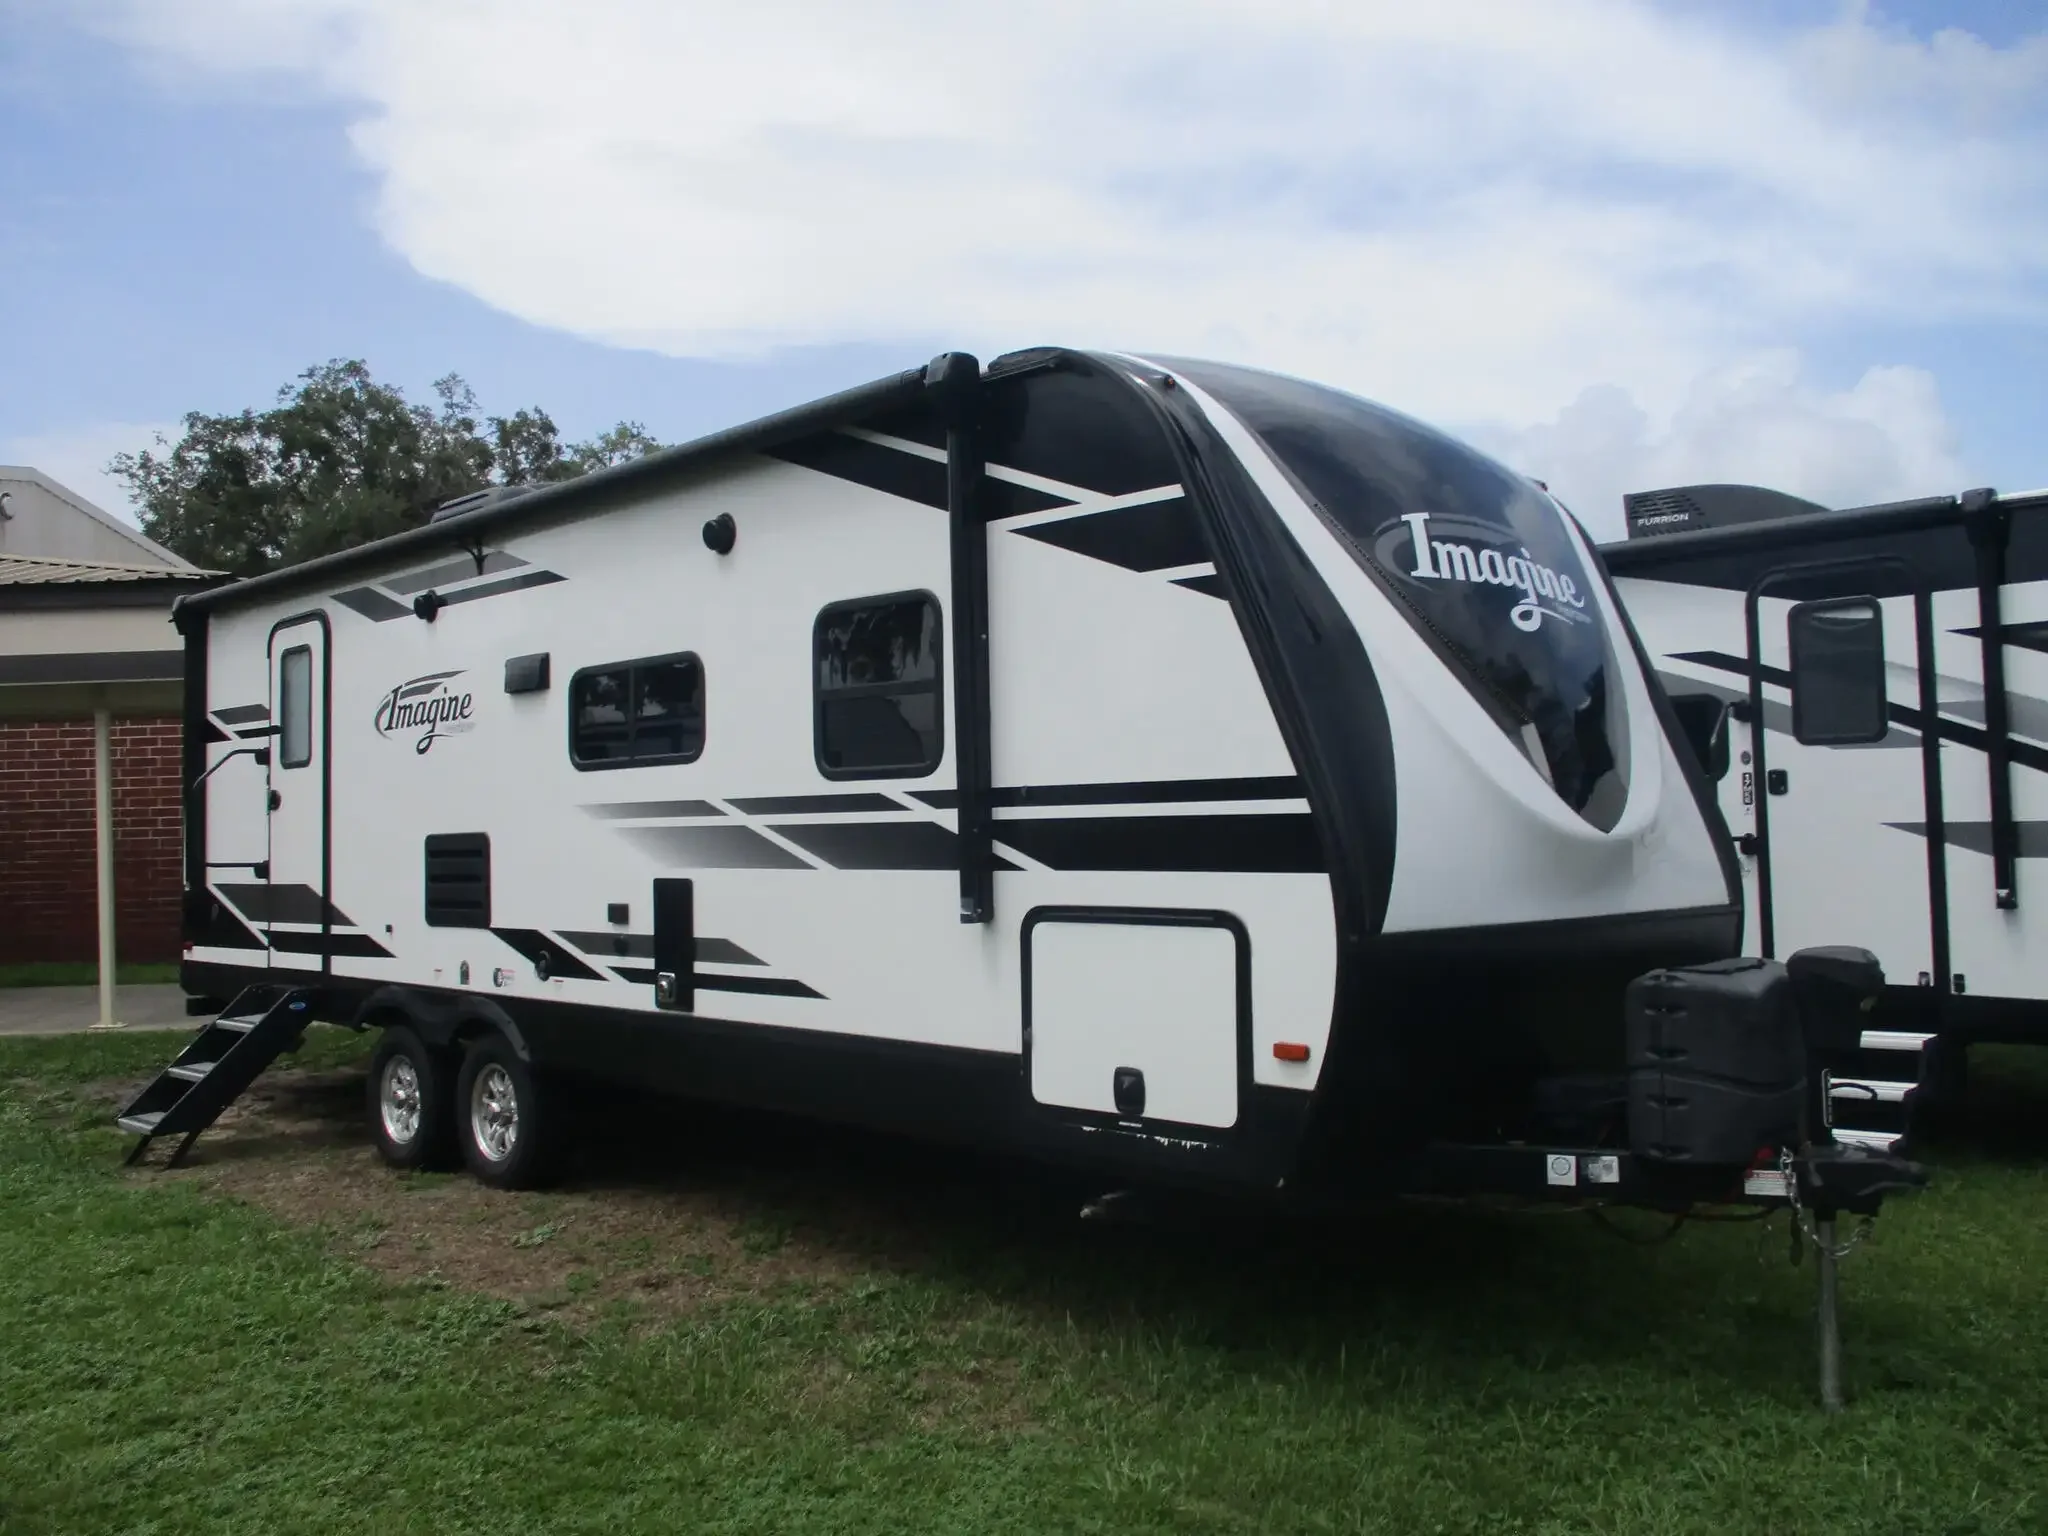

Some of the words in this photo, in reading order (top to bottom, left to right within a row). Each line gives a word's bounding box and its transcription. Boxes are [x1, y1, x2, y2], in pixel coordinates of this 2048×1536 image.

[1637, 512, 1690, 527] FURRION
[1401, 511, 1585, 632] Imagine
[383, 684, 476, 755] Imagine
